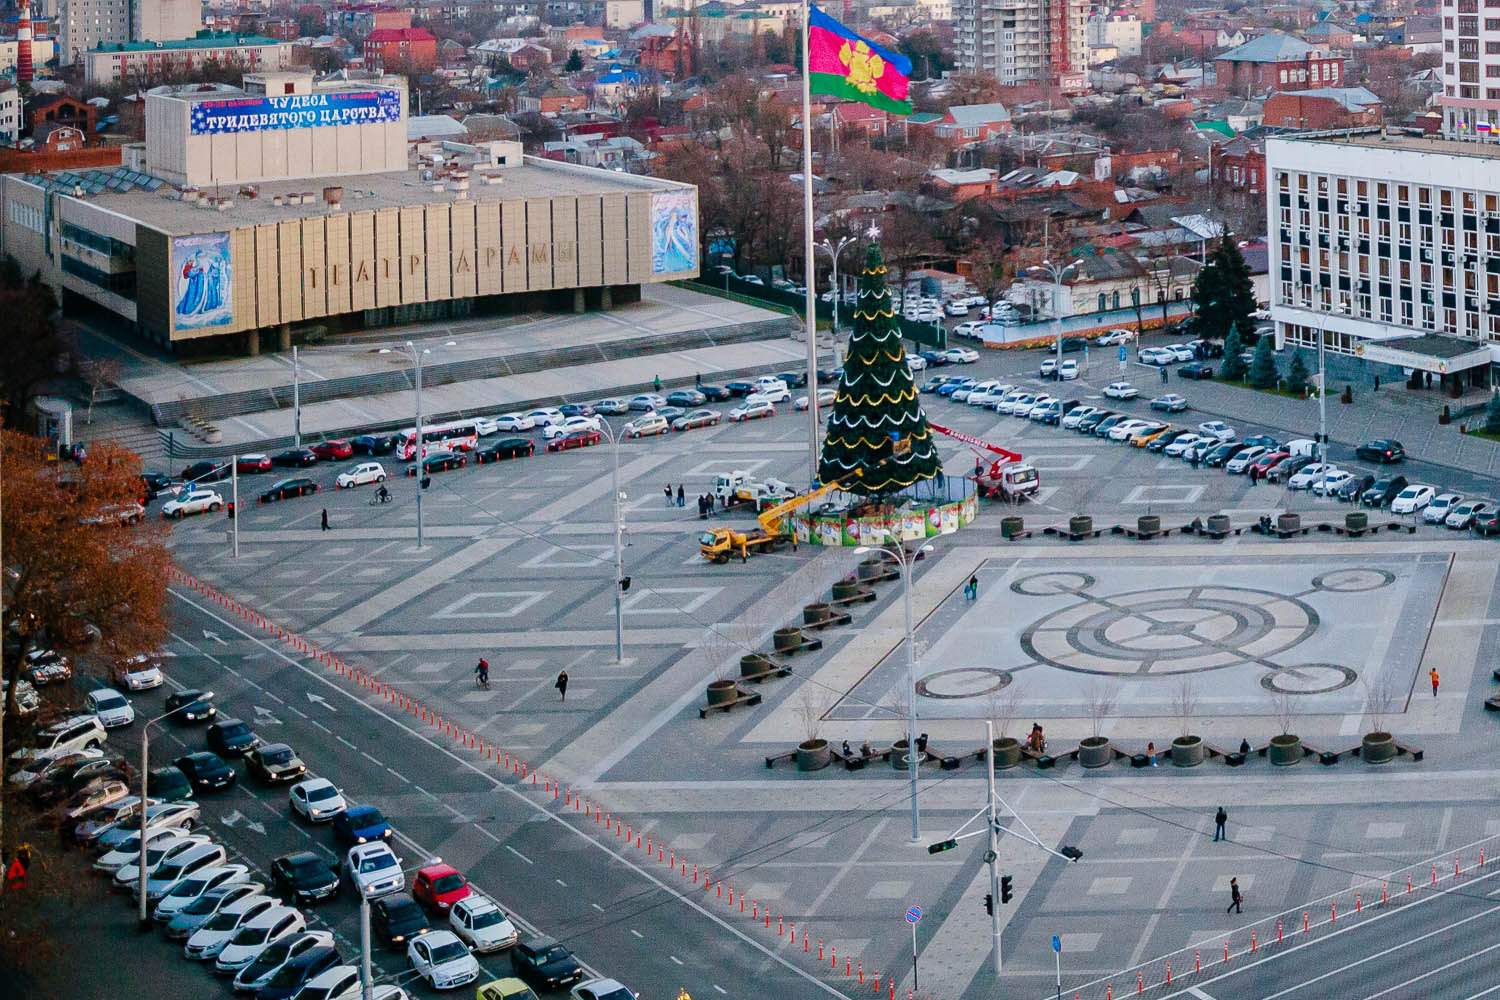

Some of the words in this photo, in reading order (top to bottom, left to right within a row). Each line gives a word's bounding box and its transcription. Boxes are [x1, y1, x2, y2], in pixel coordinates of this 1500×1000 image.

[269, 95, 328, 110] ЧУДЕСА
[206, 109, 317, 129] ТРИДЕВЯТОГО
[320, 105, 387, 122] ЦАРСТВА
[309, 254, 420, 289] ТЕАТР
